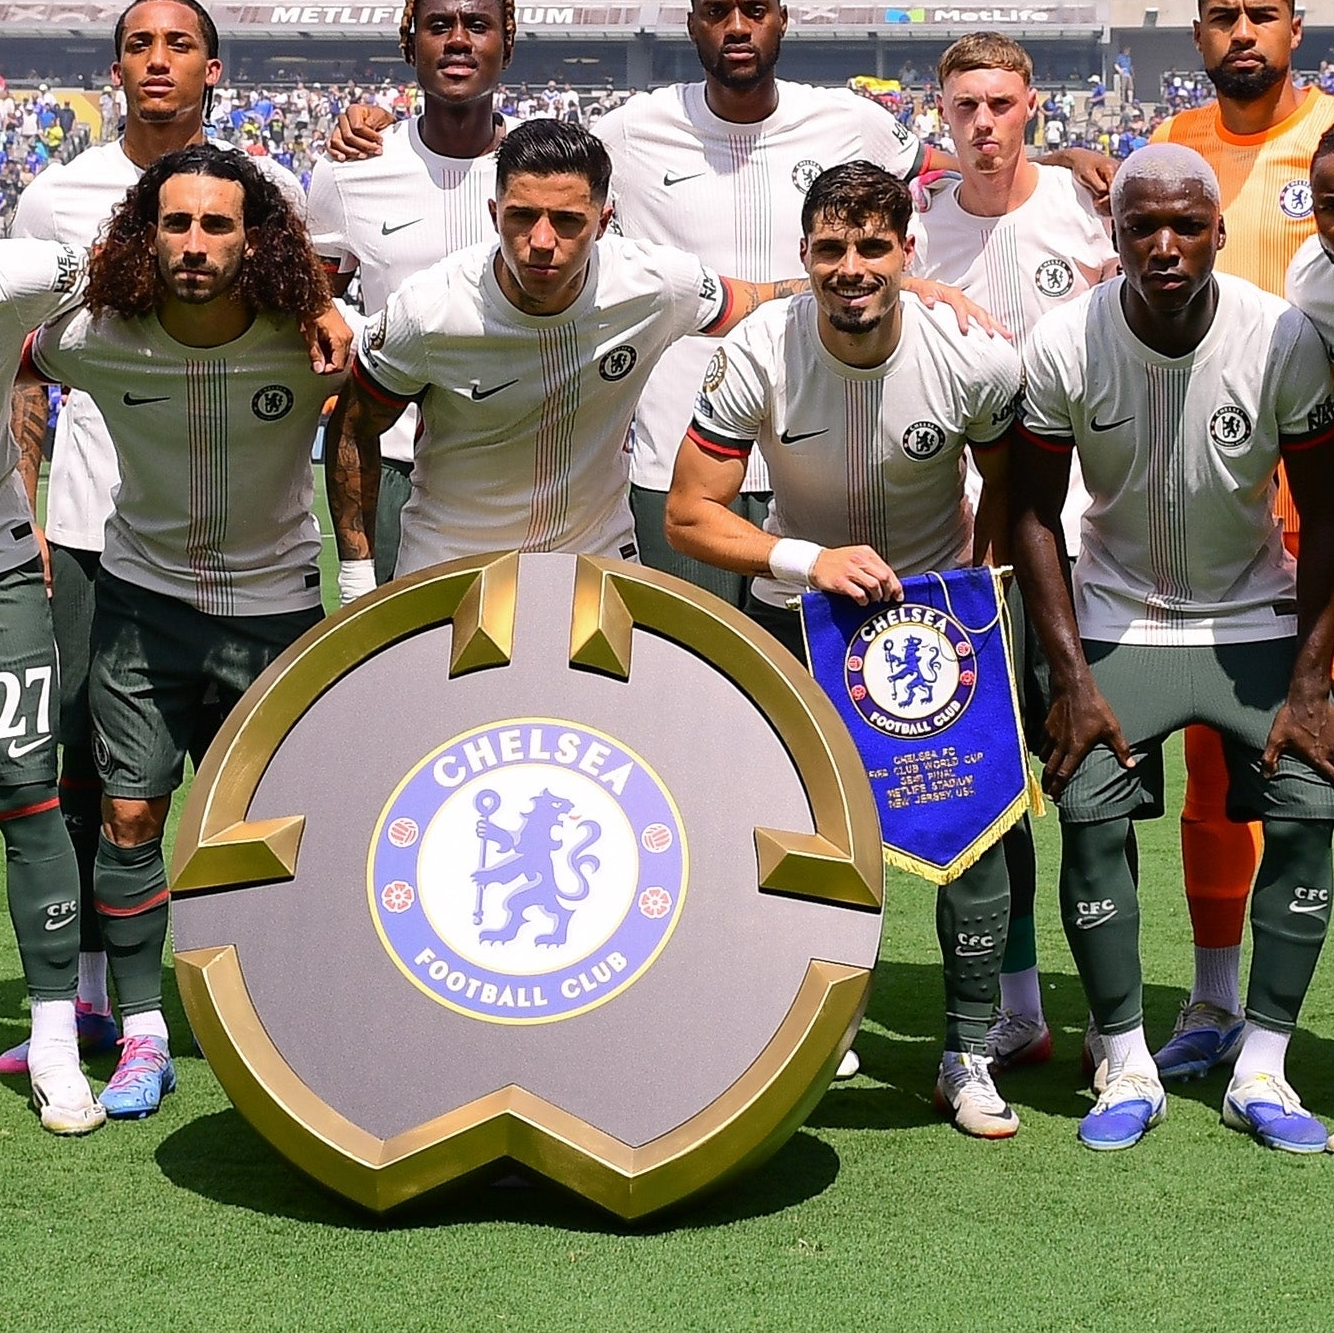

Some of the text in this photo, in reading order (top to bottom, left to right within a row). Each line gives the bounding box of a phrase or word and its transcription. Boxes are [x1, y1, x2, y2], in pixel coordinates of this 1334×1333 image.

[934, 9, 1049, 22] MetLife
[860, 608, 947, 642] CHELSEA
[870, 700, 961, 735] FOOTBALL CLUB
[433, 728, 634, 796] CHELSEA
[893, 747, 956, 765] CHELSEA FC
[893, 764, 919, 775] CLUB
[964, 752, 984, 764] CUP
[1294, 886, 1329, 902] CFC
[47, 899, 77, 917] CFC
[1076, 898, 1116, 916] CFC
[958, 932, 995, 948] CFC
[414, 947, 628, 1007] FOOTBALL CLUB
